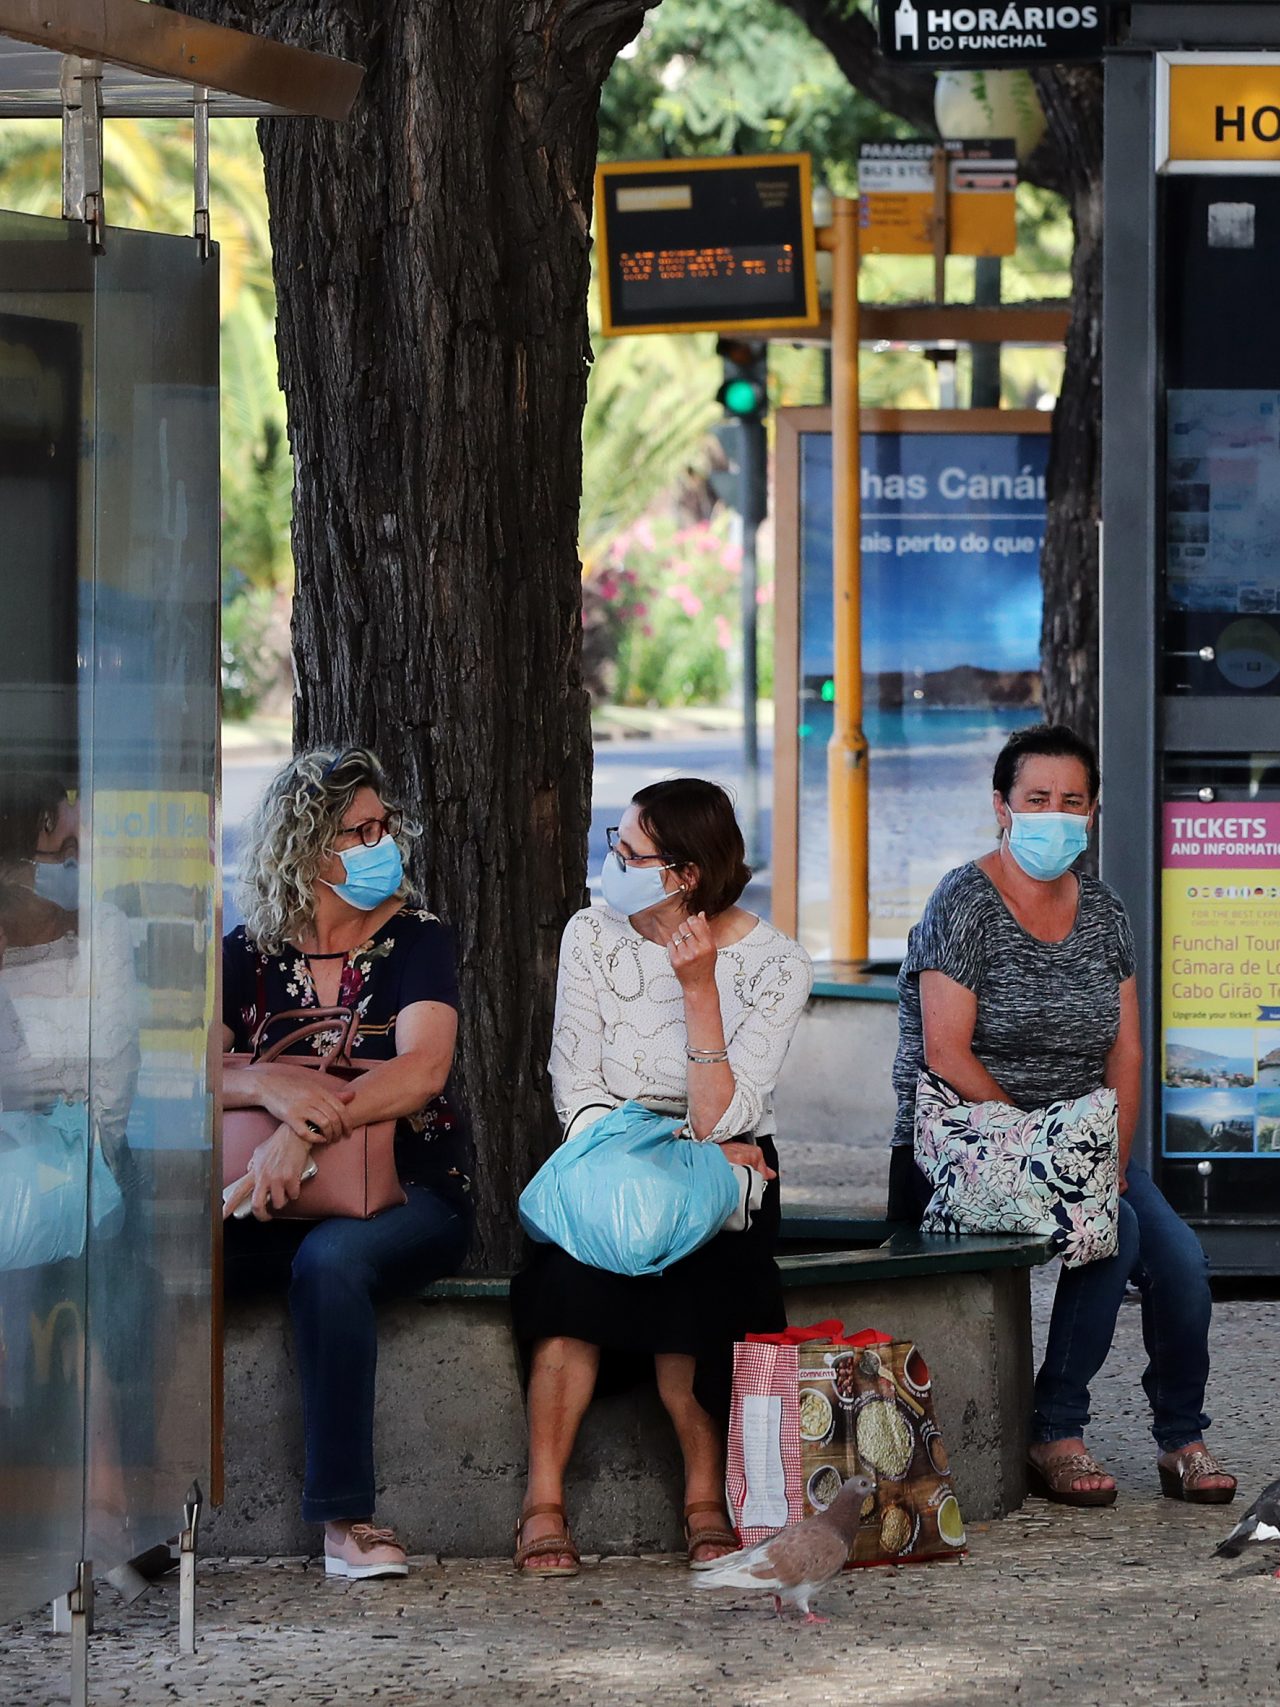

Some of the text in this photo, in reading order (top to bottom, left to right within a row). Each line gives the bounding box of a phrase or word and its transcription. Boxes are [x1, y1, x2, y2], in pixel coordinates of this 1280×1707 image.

[928, 2, 1098, 32] HORÁRIOS
[928, 34, 1046, 50] DO FUNCHAL
[862, 466, 928, 499] has
[860, 533, 891, 553] ais
[896, 531, 955, 556] perto
[960, 531, 990, 553] do
[993, 535, 1035, 556] que
[1171, 818, 1267, 839] TICKETS
[1171, 843, 1201, 856] AND
[1192, 910, 1209, 918] FOR
[1213, 910, 1228, 918] THE
[1232, 910, 1253, 918] BEST
[1172, 935, 1239, 951] Funchal
[1172, 958, 1234, 975] Câmara
[1240, 959, 1261, 975] de
[1172, 983, 1214, 999] Cabo
[1219, 983, 1263, 999] Girão
[1172, 1011, 1206, 1020] Upgrade
[1209, 1012, 1226, 1020] your
